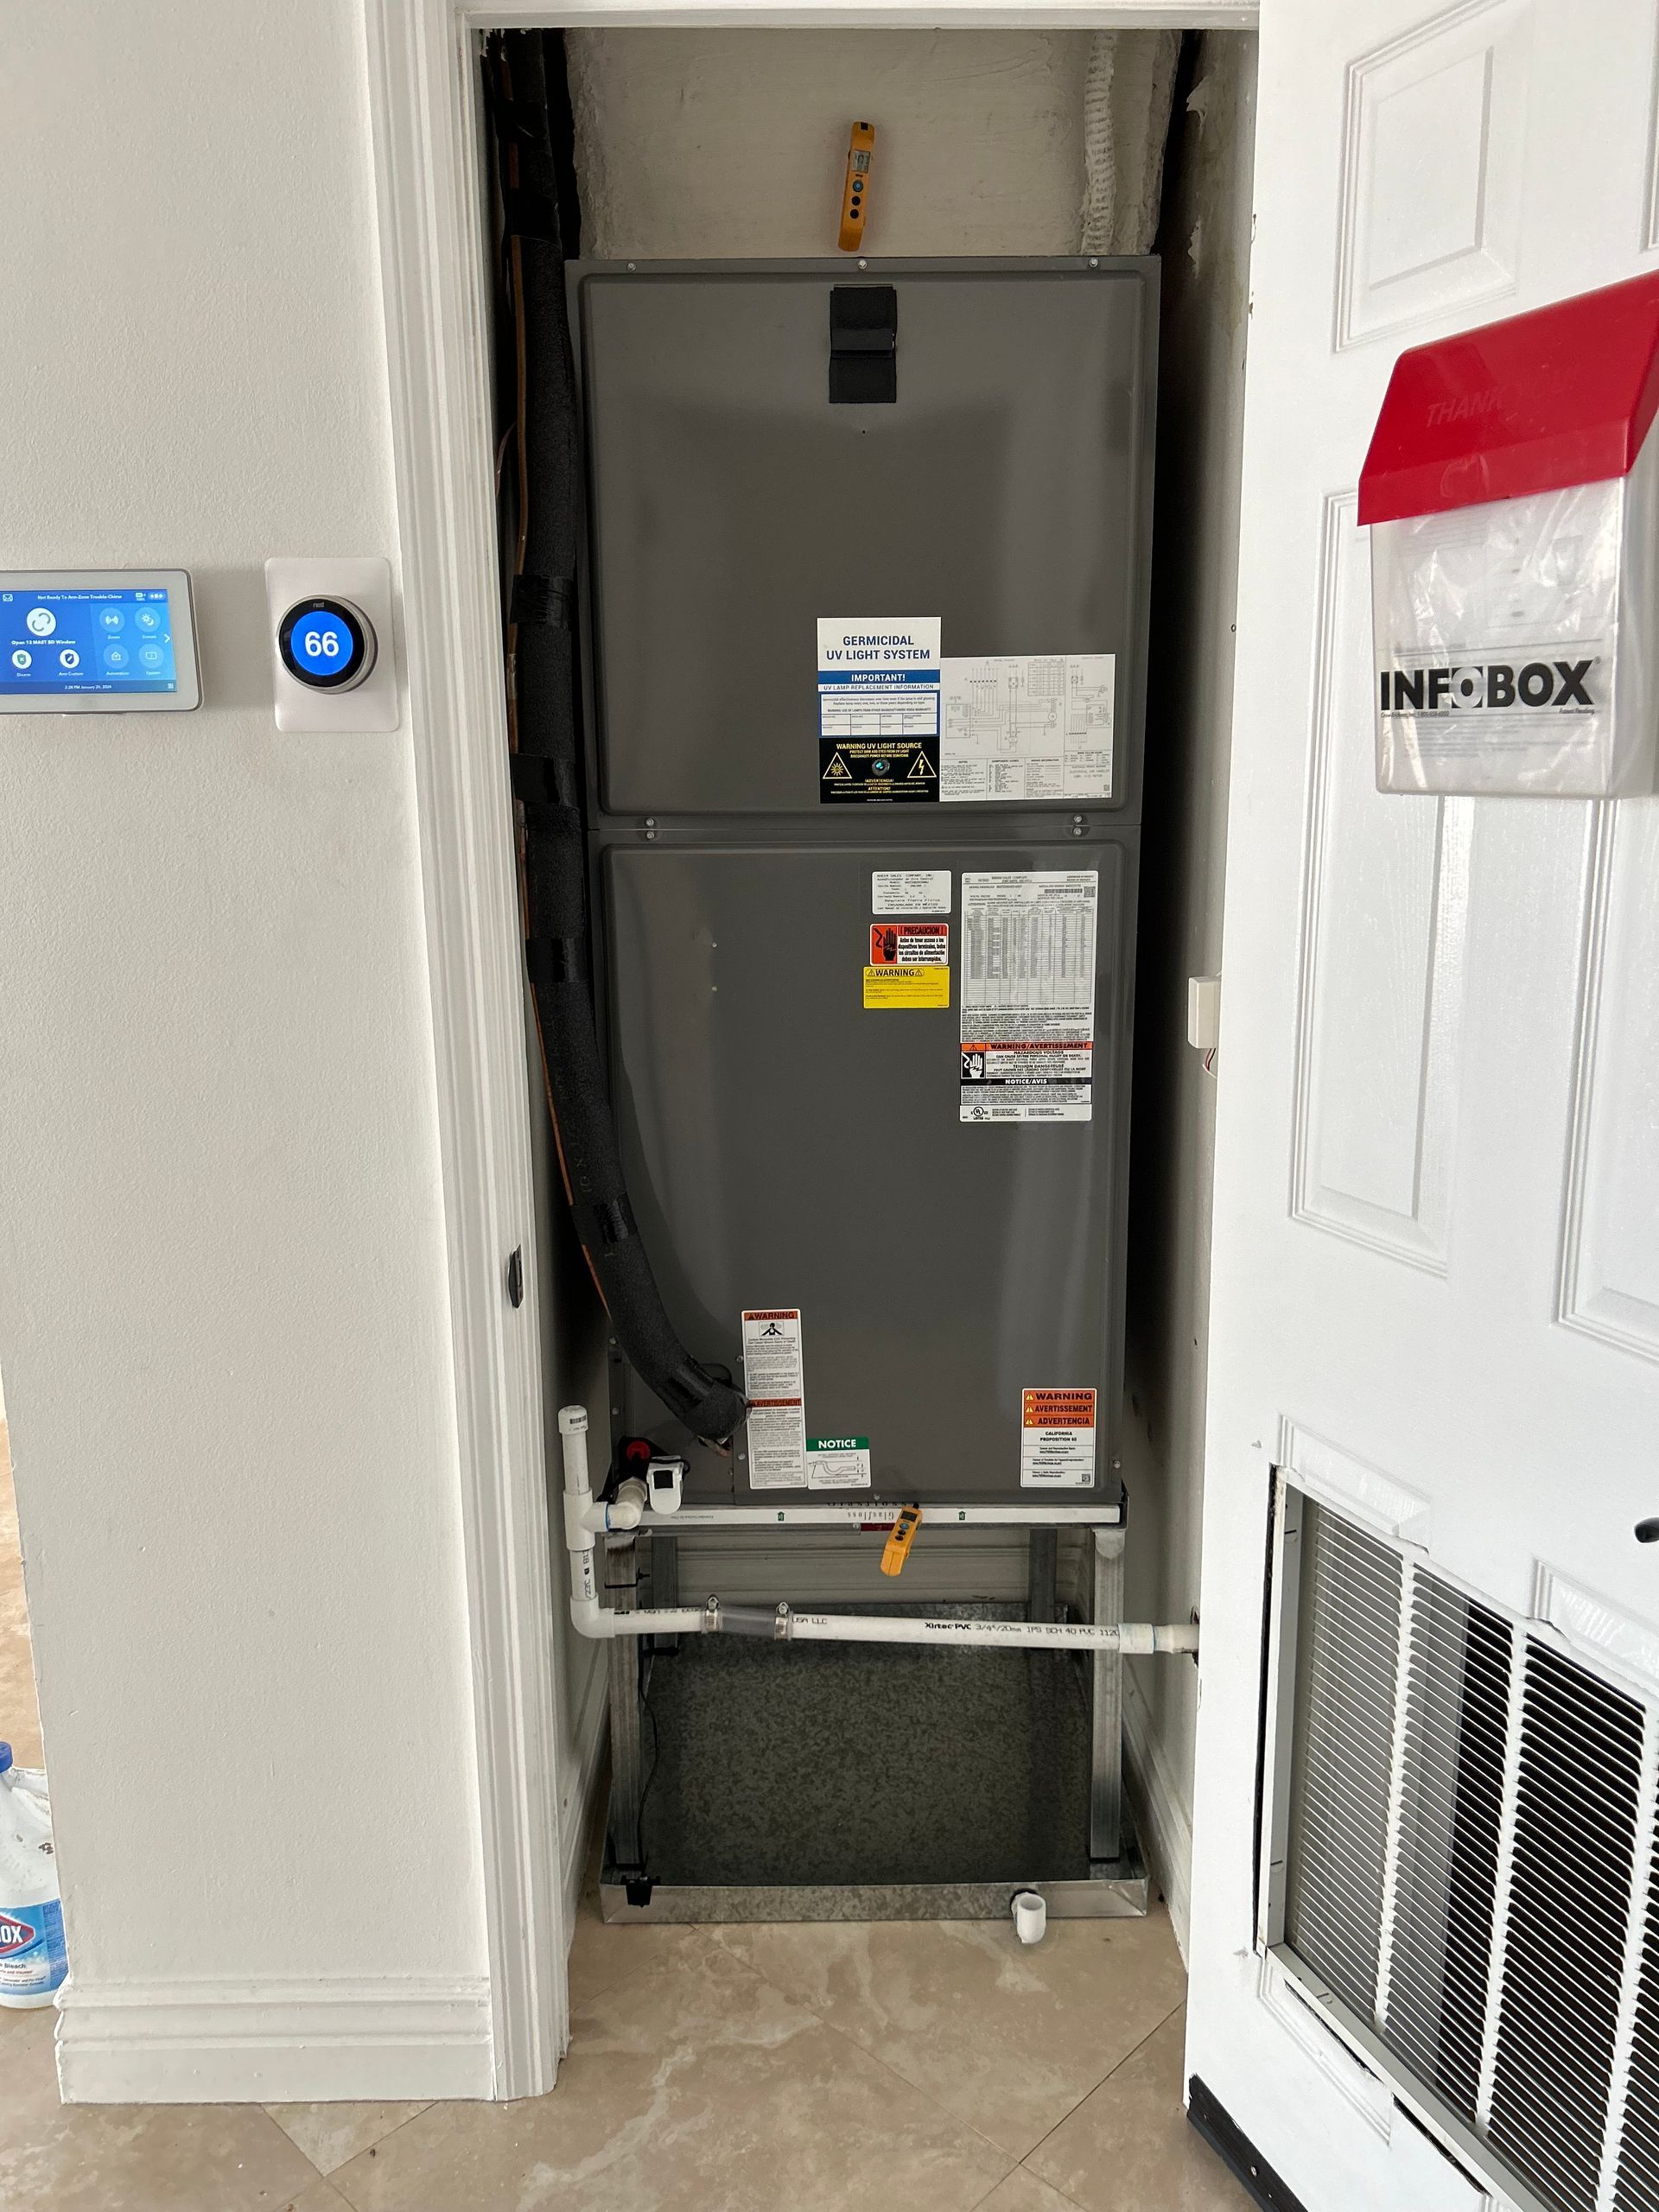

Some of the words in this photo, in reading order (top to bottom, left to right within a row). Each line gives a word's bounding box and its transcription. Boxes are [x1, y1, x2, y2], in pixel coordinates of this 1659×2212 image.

[305, 631, 339, 657] 66
[843, 636, 914, 645] GERMICIDAL
[826, 650, 842, 660] UV
[847, 650, 880, 659] LIGHT
[883, 650, 930, 659] SYSTEM
[1381, 660, 1595, 710] INFOBOX
[818, 1440, 856, 1448] NOTICE
[0, 1925, 23, 1943] OX
